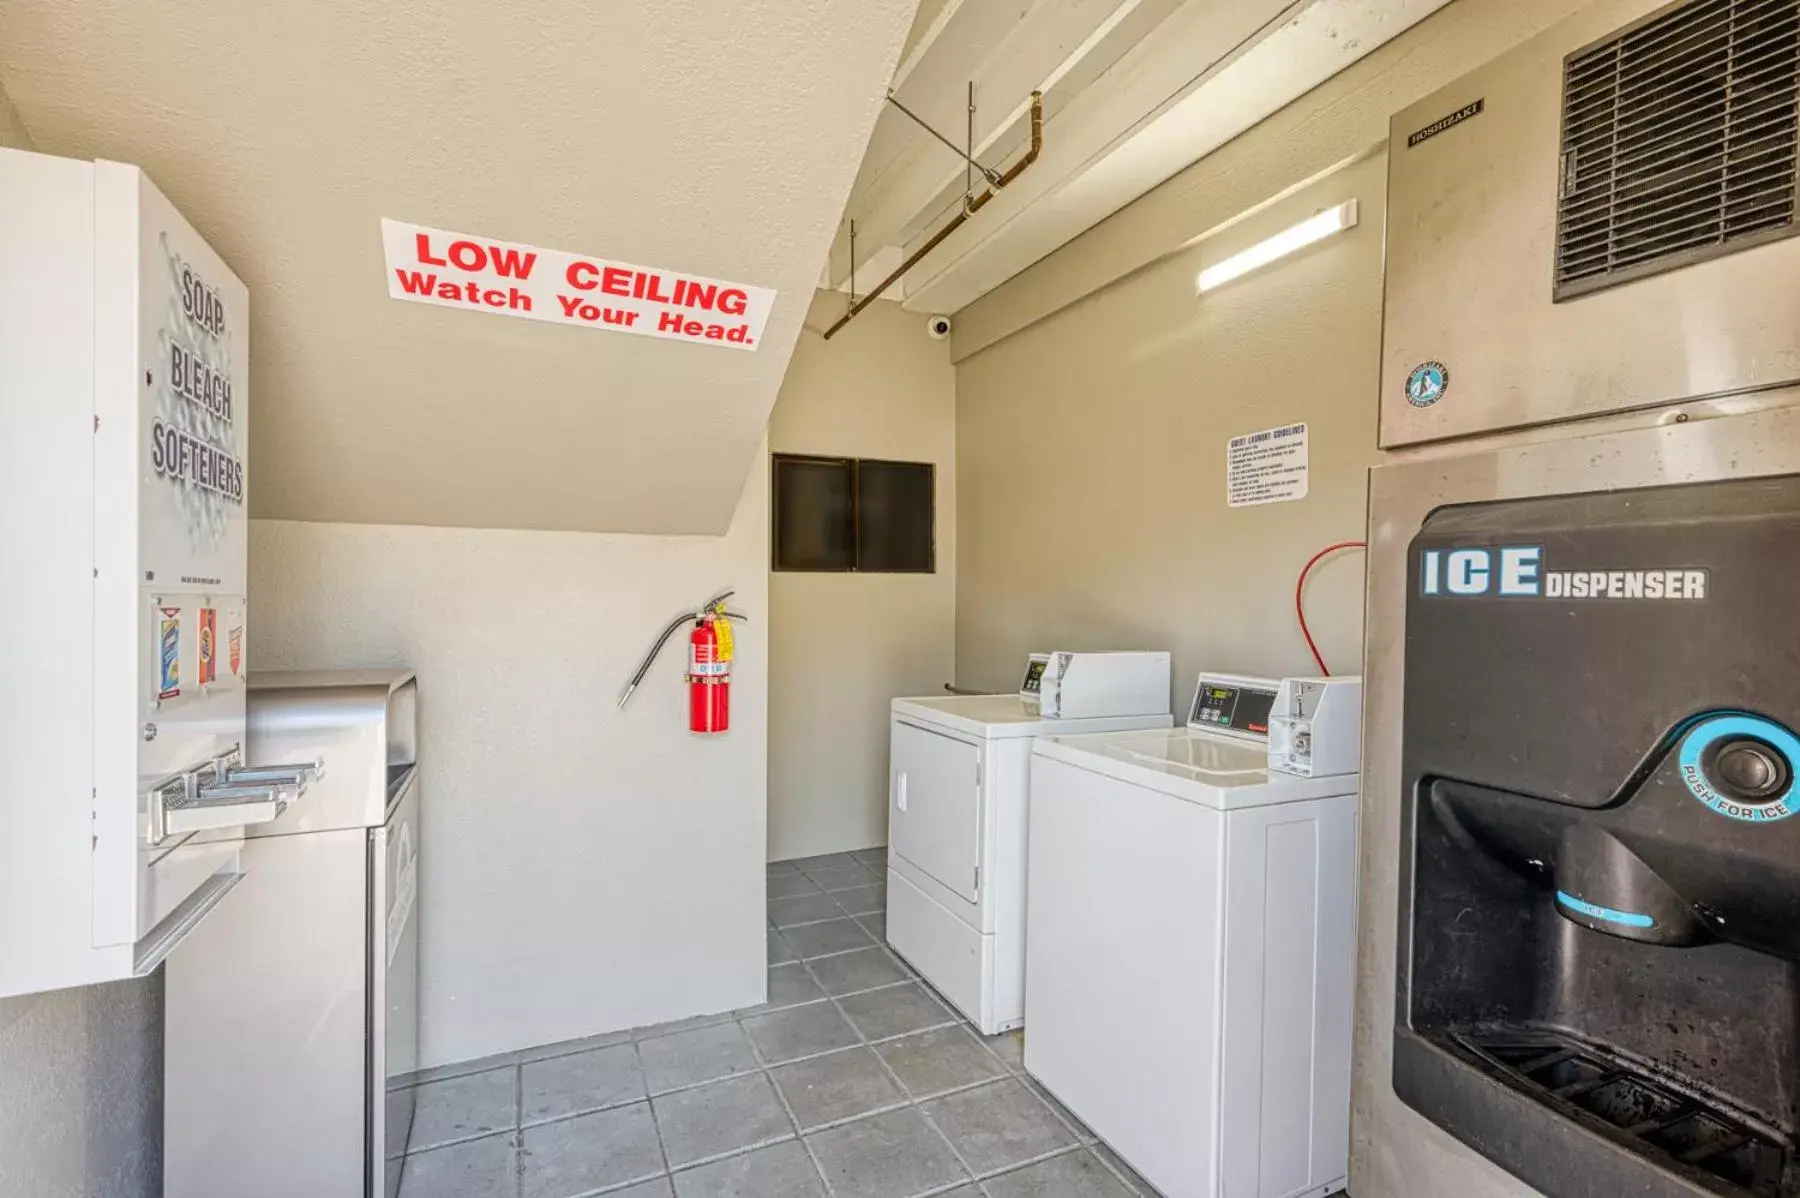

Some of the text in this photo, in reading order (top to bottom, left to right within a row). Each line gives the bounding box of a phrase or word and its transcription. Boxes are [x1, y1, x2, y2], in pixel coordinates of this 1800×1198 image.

[1411, 104, 1477, 143] HOSHIZAKI
[182, 267, 224, 336] SOAP
[395, 268, 754, 344] Watch Your Head.
[416, 233, 748, 316] LOW CEILING
[171, 343, 232, 420] BLEACH
[153, 421, 242, 499] SOFTENERS
[1248, 432, 1271, 444] LAUNDRY
[1273, 424, 1305, 438] GUIDELINES
[1424, 546, 1705, 599] ICE DISPENSER
[1684, 765, 1788, 819] PUSH FOR ICE
